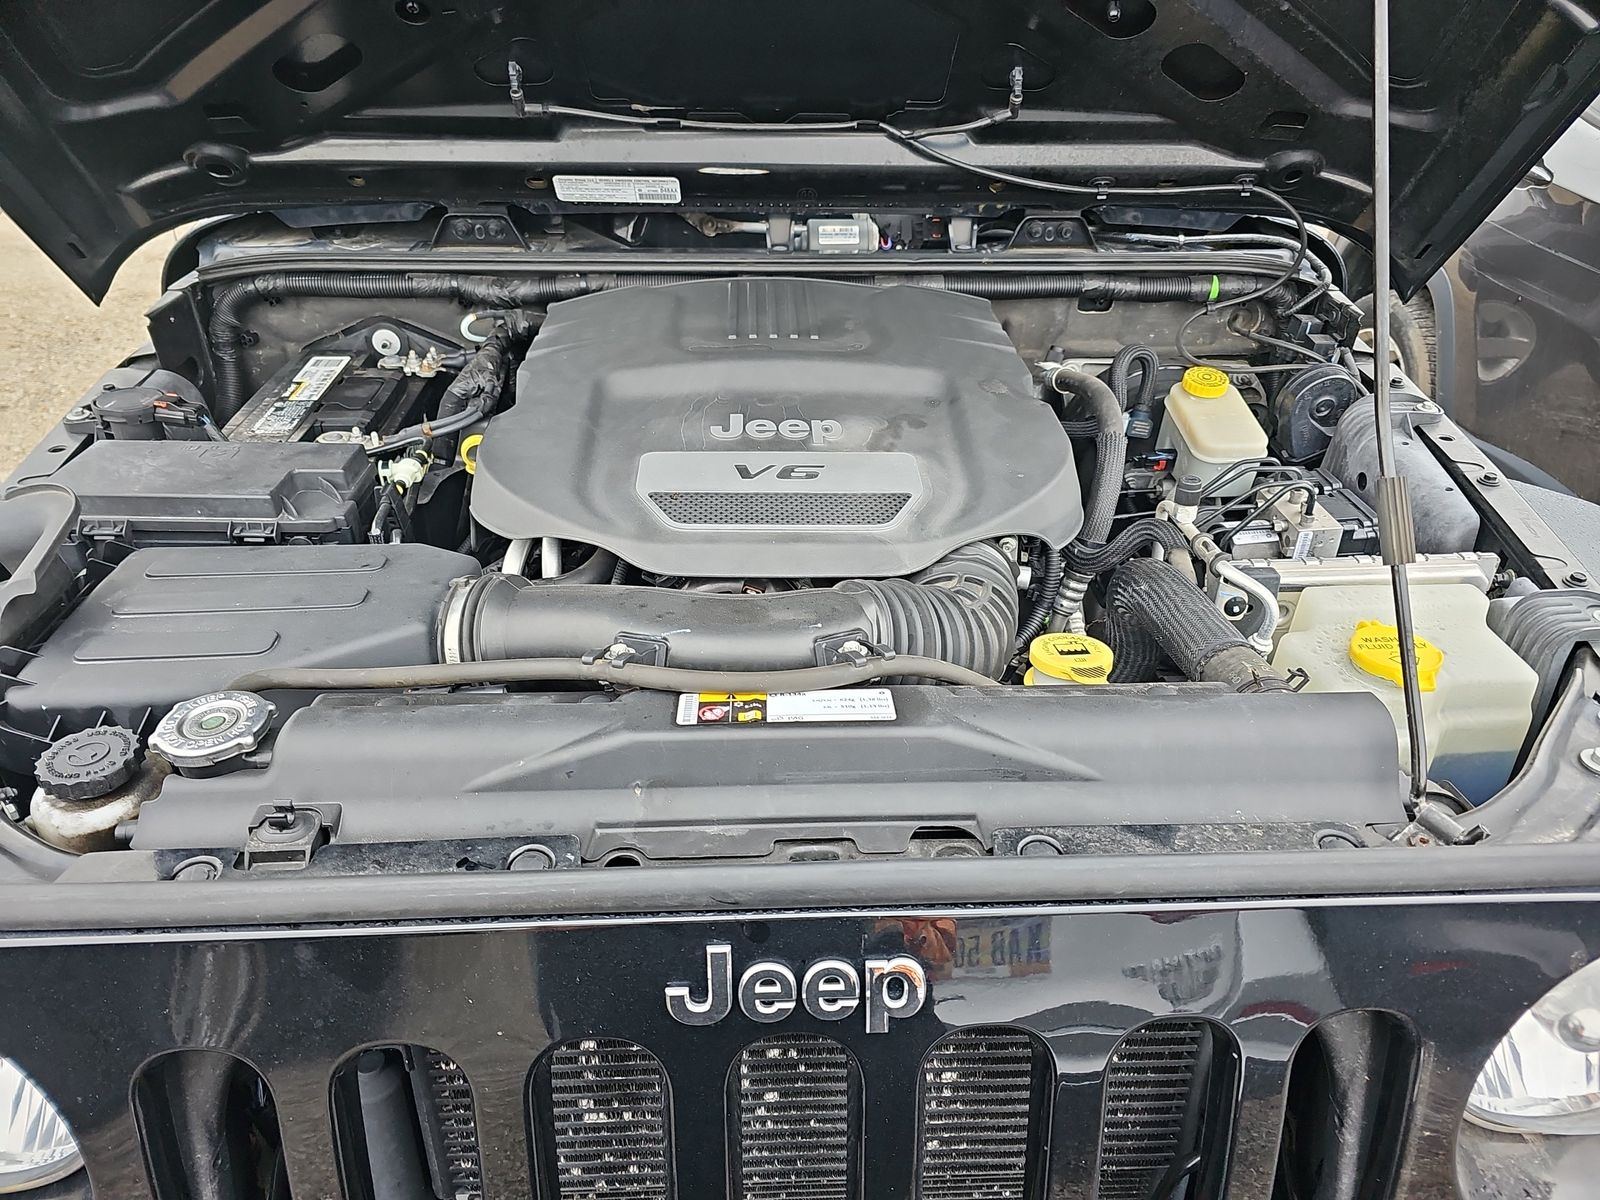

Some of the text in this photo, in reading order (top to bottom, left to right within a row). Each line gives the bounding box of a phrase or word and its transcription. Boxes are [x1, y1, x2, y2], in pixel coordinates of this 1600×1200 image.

[710, 413, 843, 446] Jeep
[733, 464, 826, 480] V6
[188, 693, 226, 709] KEEP
[186, 735, 225, 749] OPEN
[227, 721, 252, 738] HOT
[664, 943, 927, 1034] Jeep
